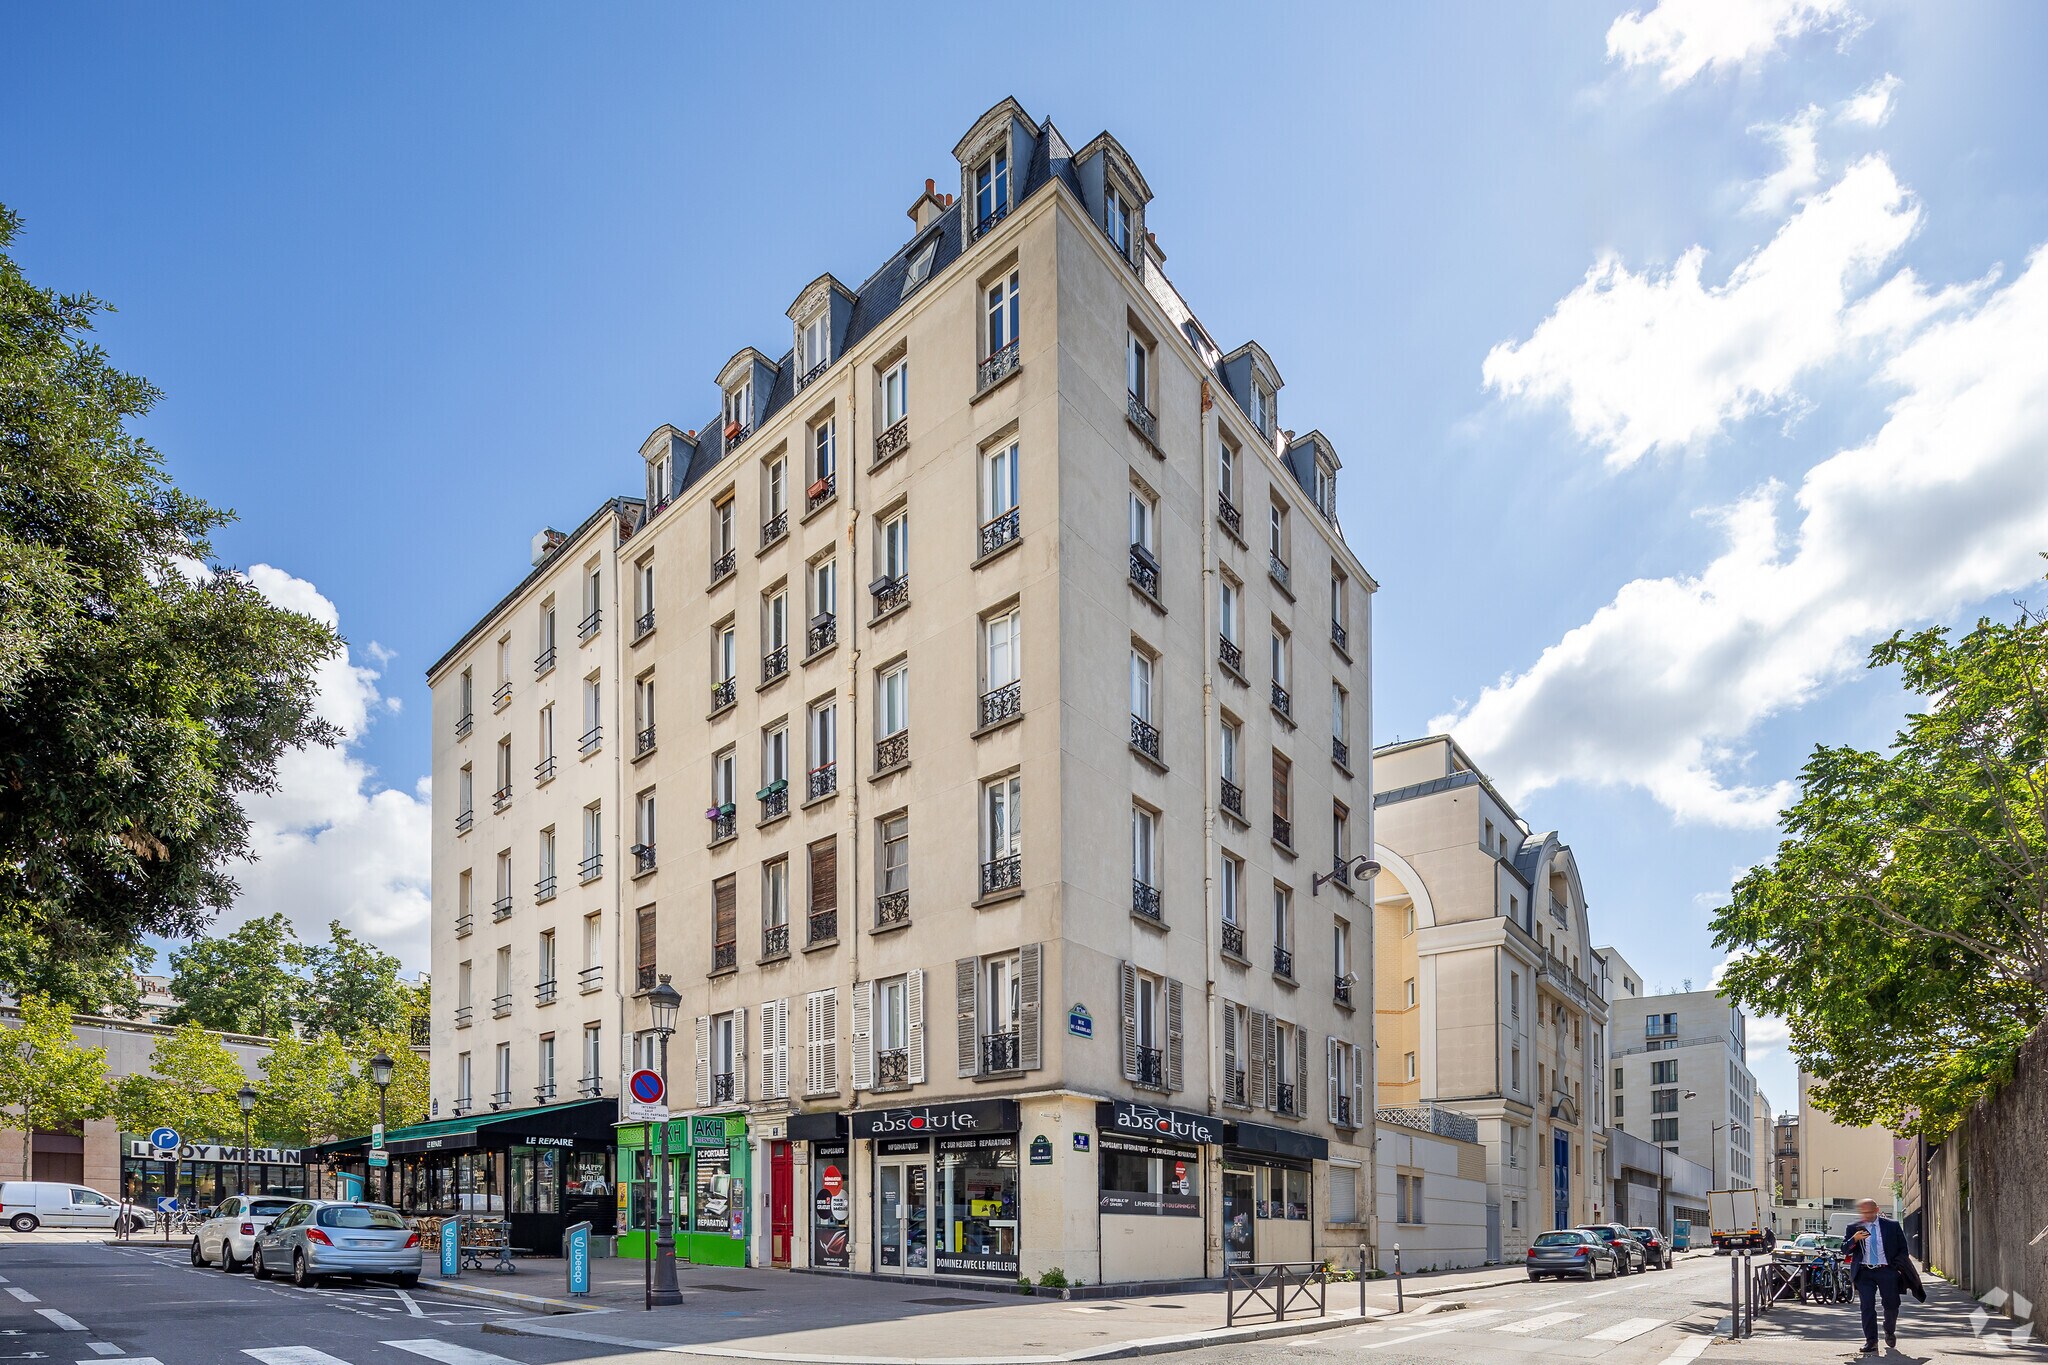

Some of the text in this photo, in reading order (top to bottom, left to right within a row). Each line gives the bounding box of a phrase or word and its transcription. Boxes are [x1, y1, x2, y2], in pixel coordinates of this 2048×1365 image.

[695, 1119, 723, 1136] AKH
[872, 1108, 979, 1132] absolute PC
[1117, 1104, 1213, 1143] absolute PC
[526, 1136, 573, 1147] LE REPAIRE
[957, 1140, 976, 1148] MESURES
[134, 1143, 300, 1163] LOY MERLIN
[697, 1149, 728, 1158] PC PORTABLE
[579, 1163, 603, 1171] HAPPY
[698, 1219, 728, 1227] REPARATION
[446, 1238, 454, 1267] ubeeqo
[574, 1249, 584, 1283] ubeeqo
[936, 1258, 1017, 1272] DOMINEZ AVEC LE MEILLEUR
